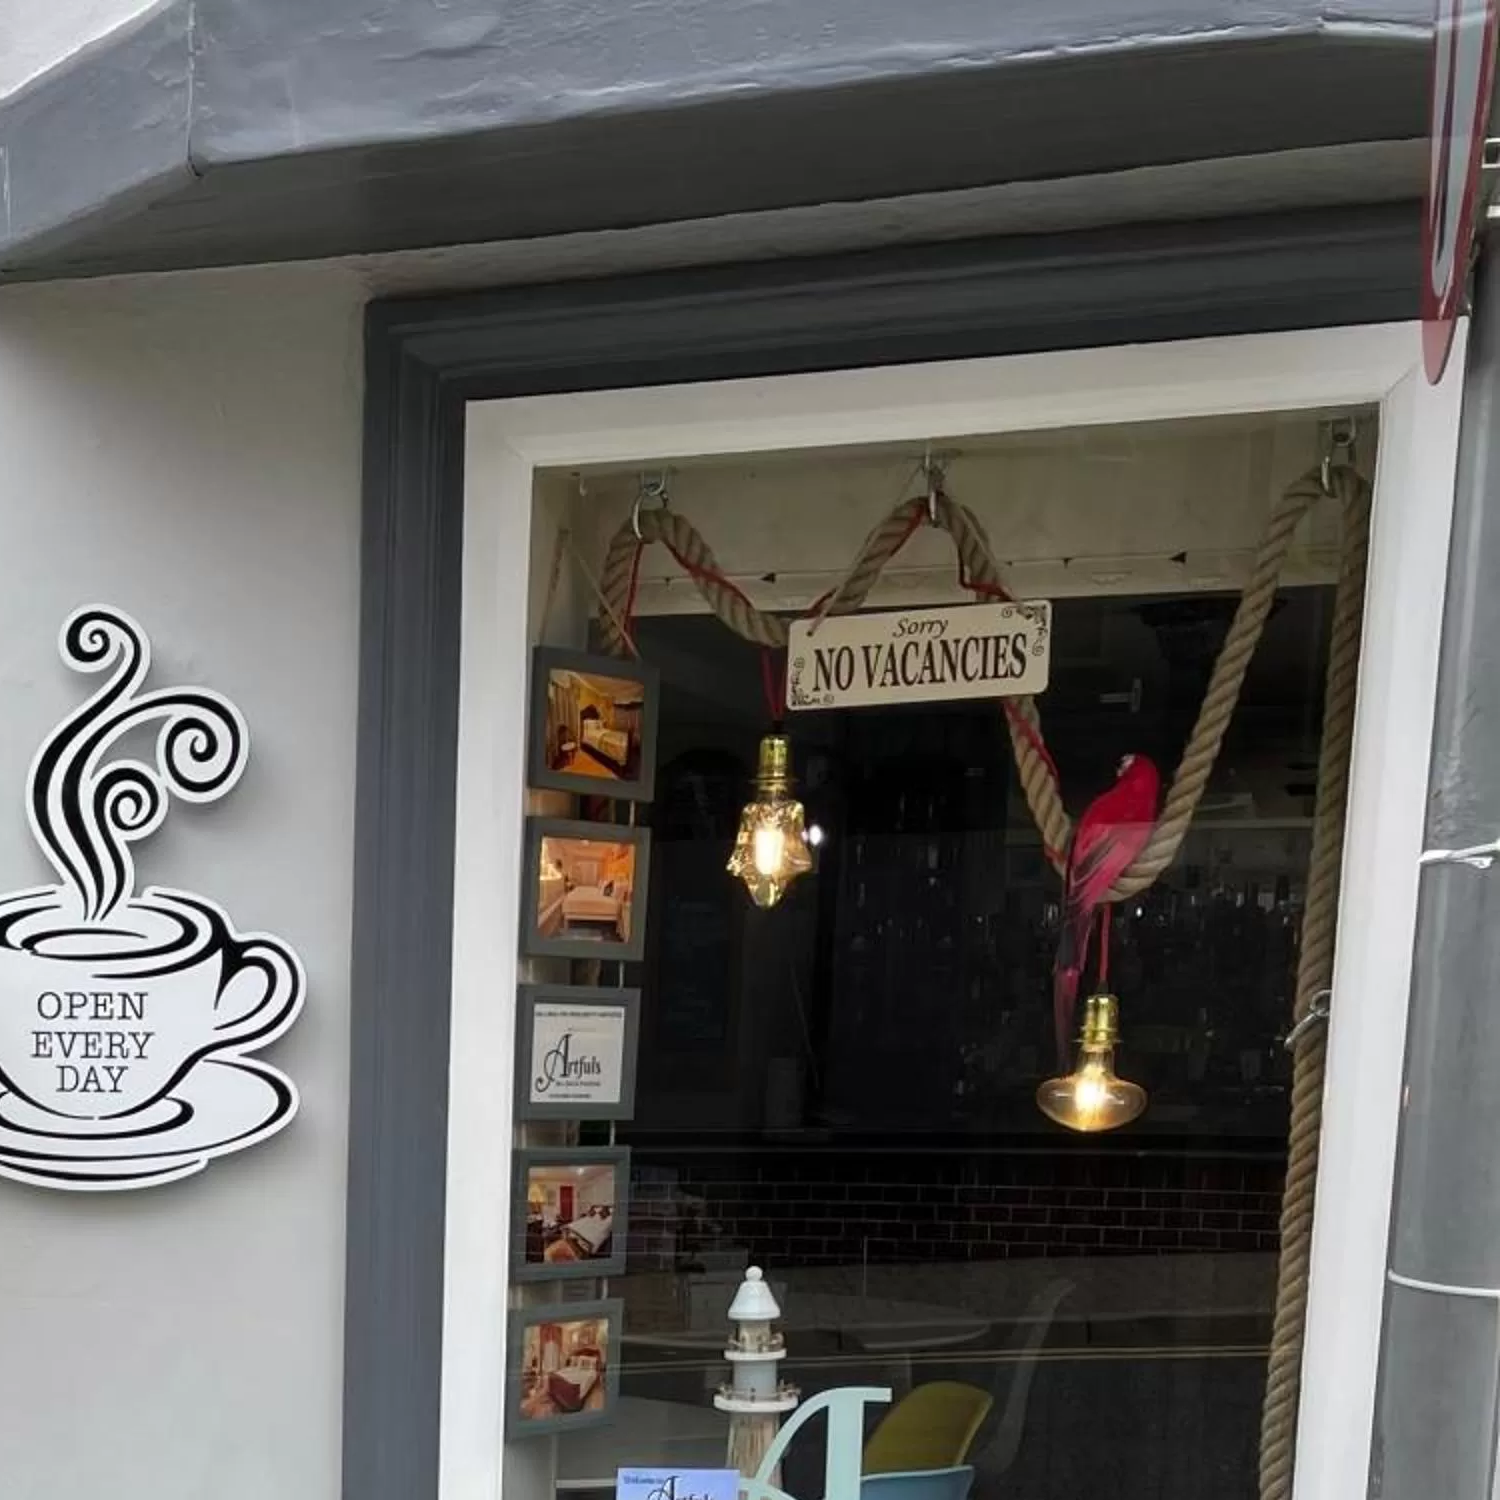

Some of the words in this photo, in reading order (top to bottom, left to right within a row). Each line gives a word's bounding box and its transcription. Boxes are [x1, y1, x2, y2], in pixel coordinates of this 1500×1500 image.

[892, 617, 949, 639] Sorry
[812, 645, 856, 692] NO
[861, 632, 1028, 689] VACANCIES
[37, 991, 149, 1020] OPEN
[31, 1031, 155, 1059] EVERY
[535, 1033, 602, 1093] Artfuls
[56, 1065, 129, 1093] DAY
